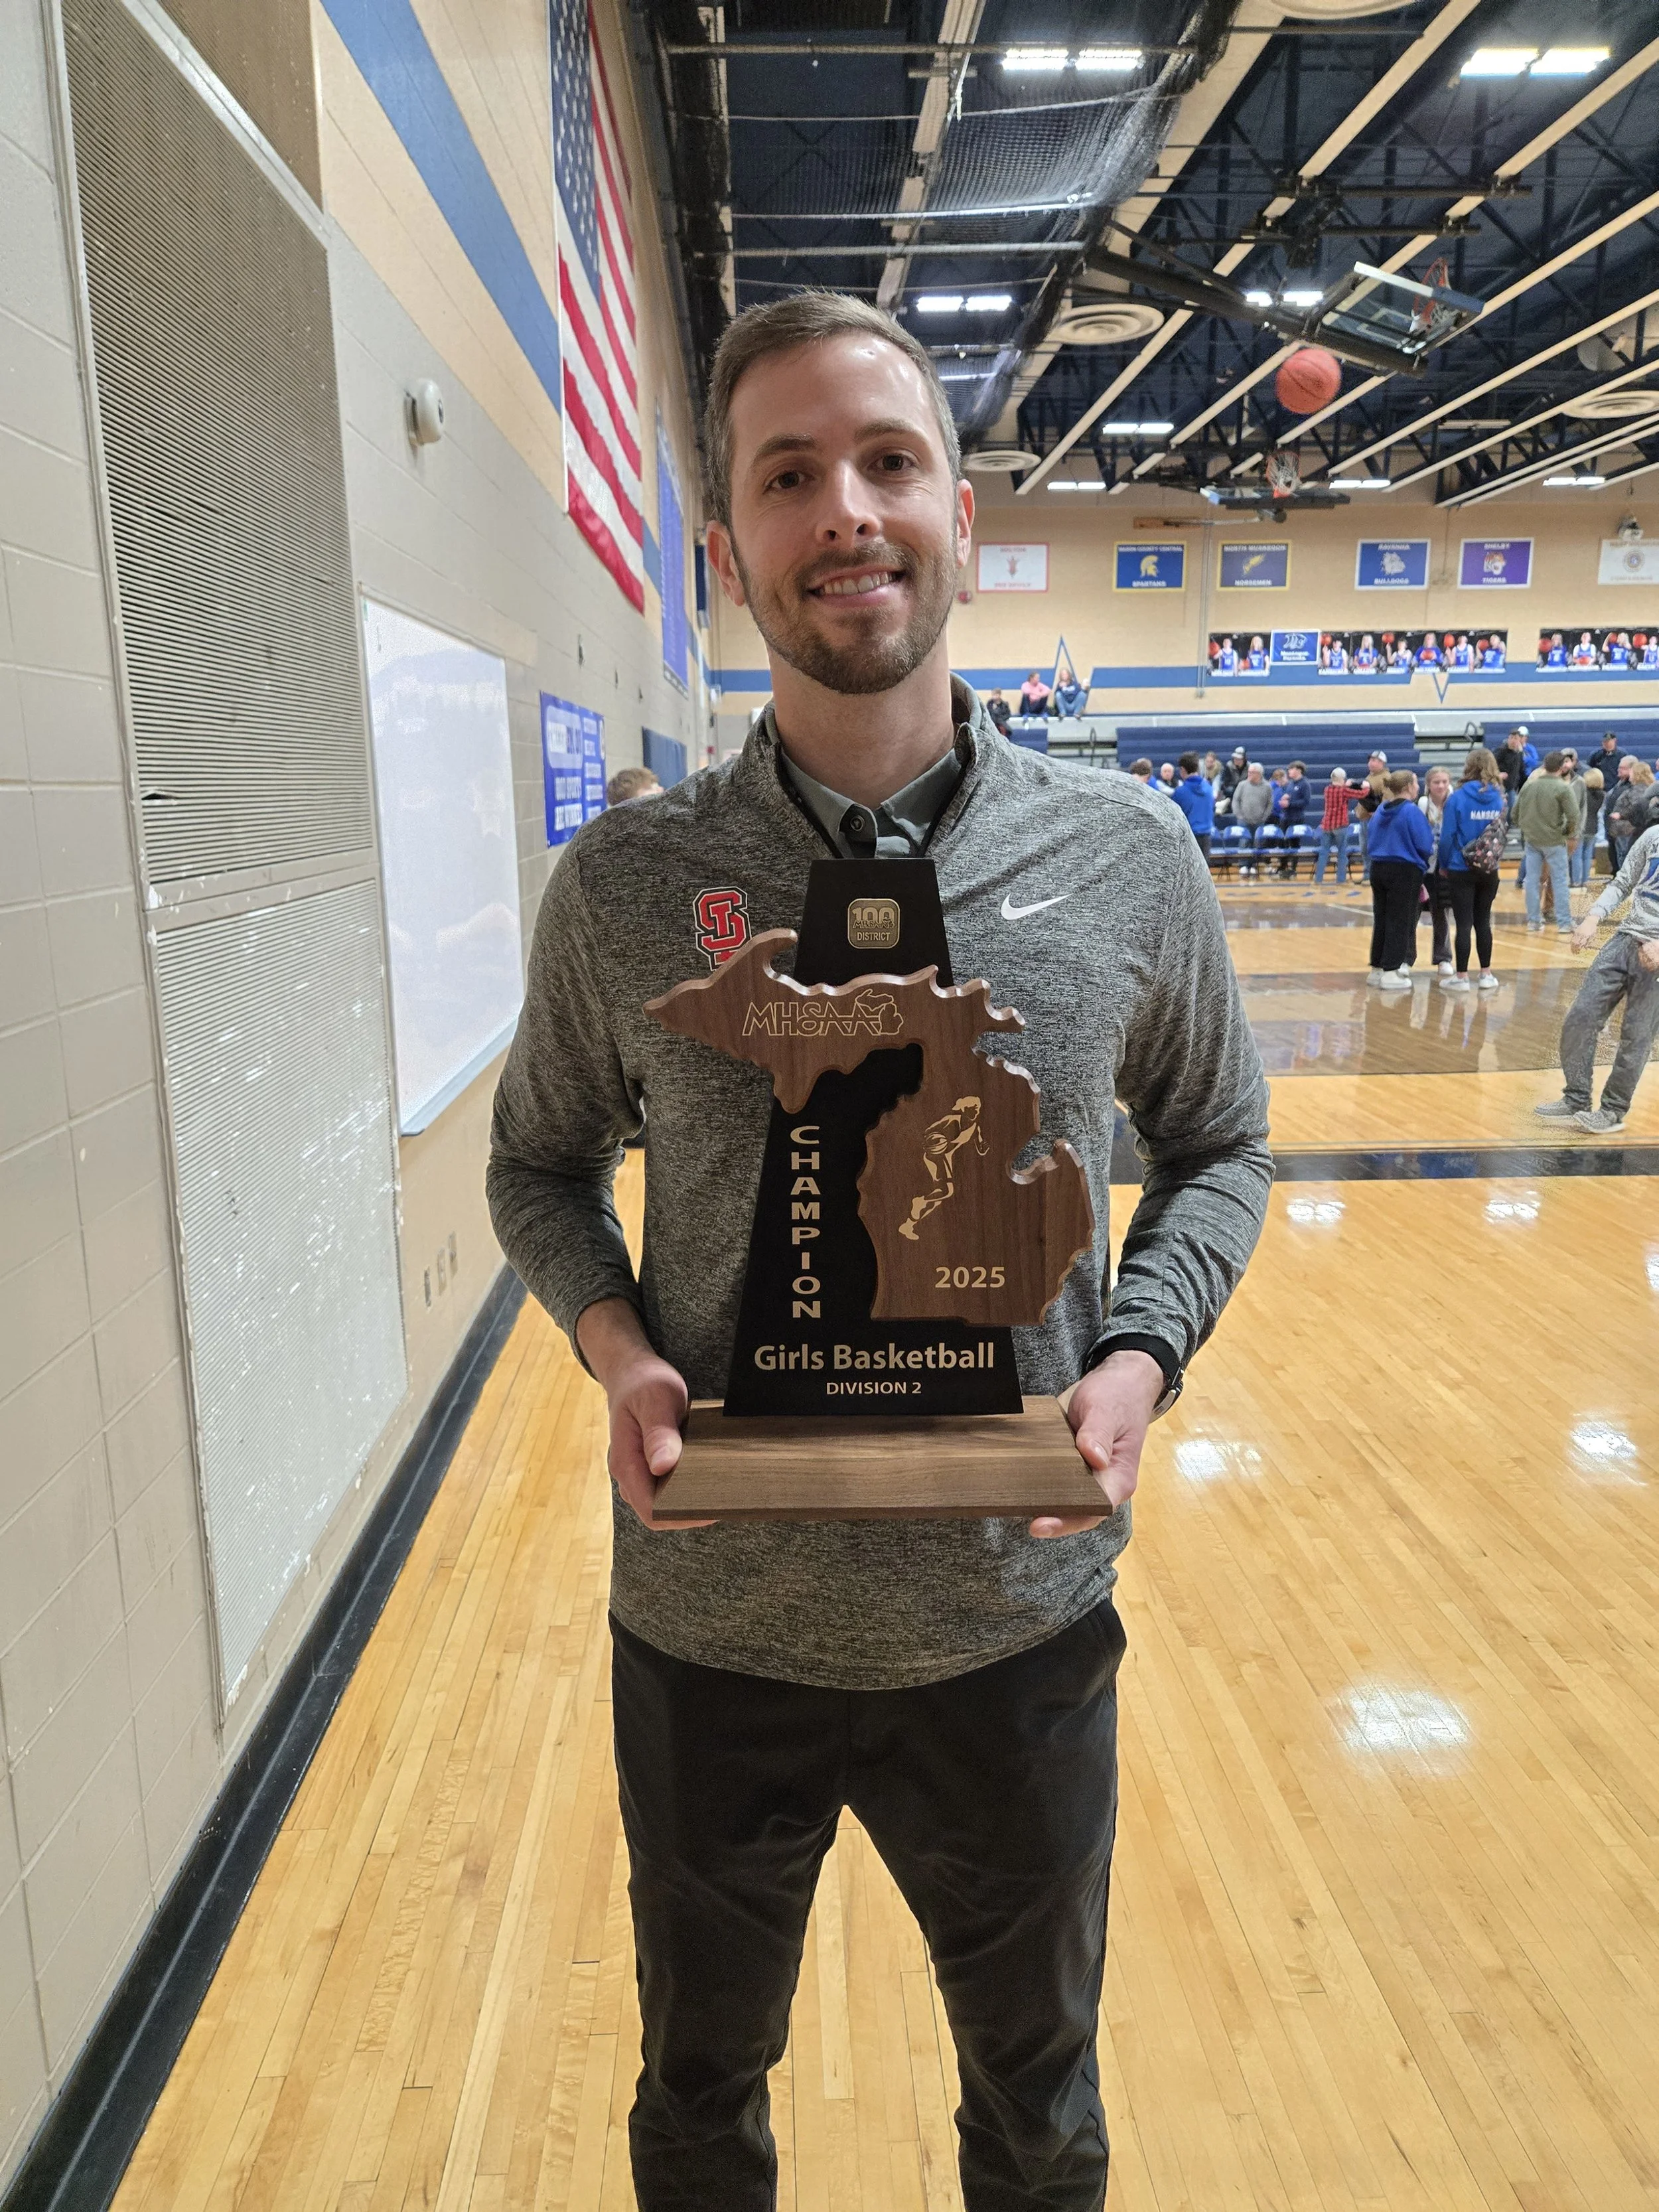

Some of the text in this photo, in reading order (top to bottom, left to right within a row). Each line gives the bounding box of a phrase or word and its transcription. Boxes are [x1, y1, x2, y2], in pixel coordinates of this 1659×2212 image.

[852, 907, 895, 924] 100
[857, 932, 891, 940] DISTRICT
[742, 1001, 881, 1037] MHSAA
[790, 1126, 822, 1319] CHAMPION
[934, 1266, 1005, 1289] 2025
[754, 1341, 994, 1370] Girls Basketball
[826, 1381, 922, 1395] DIVISION 2
